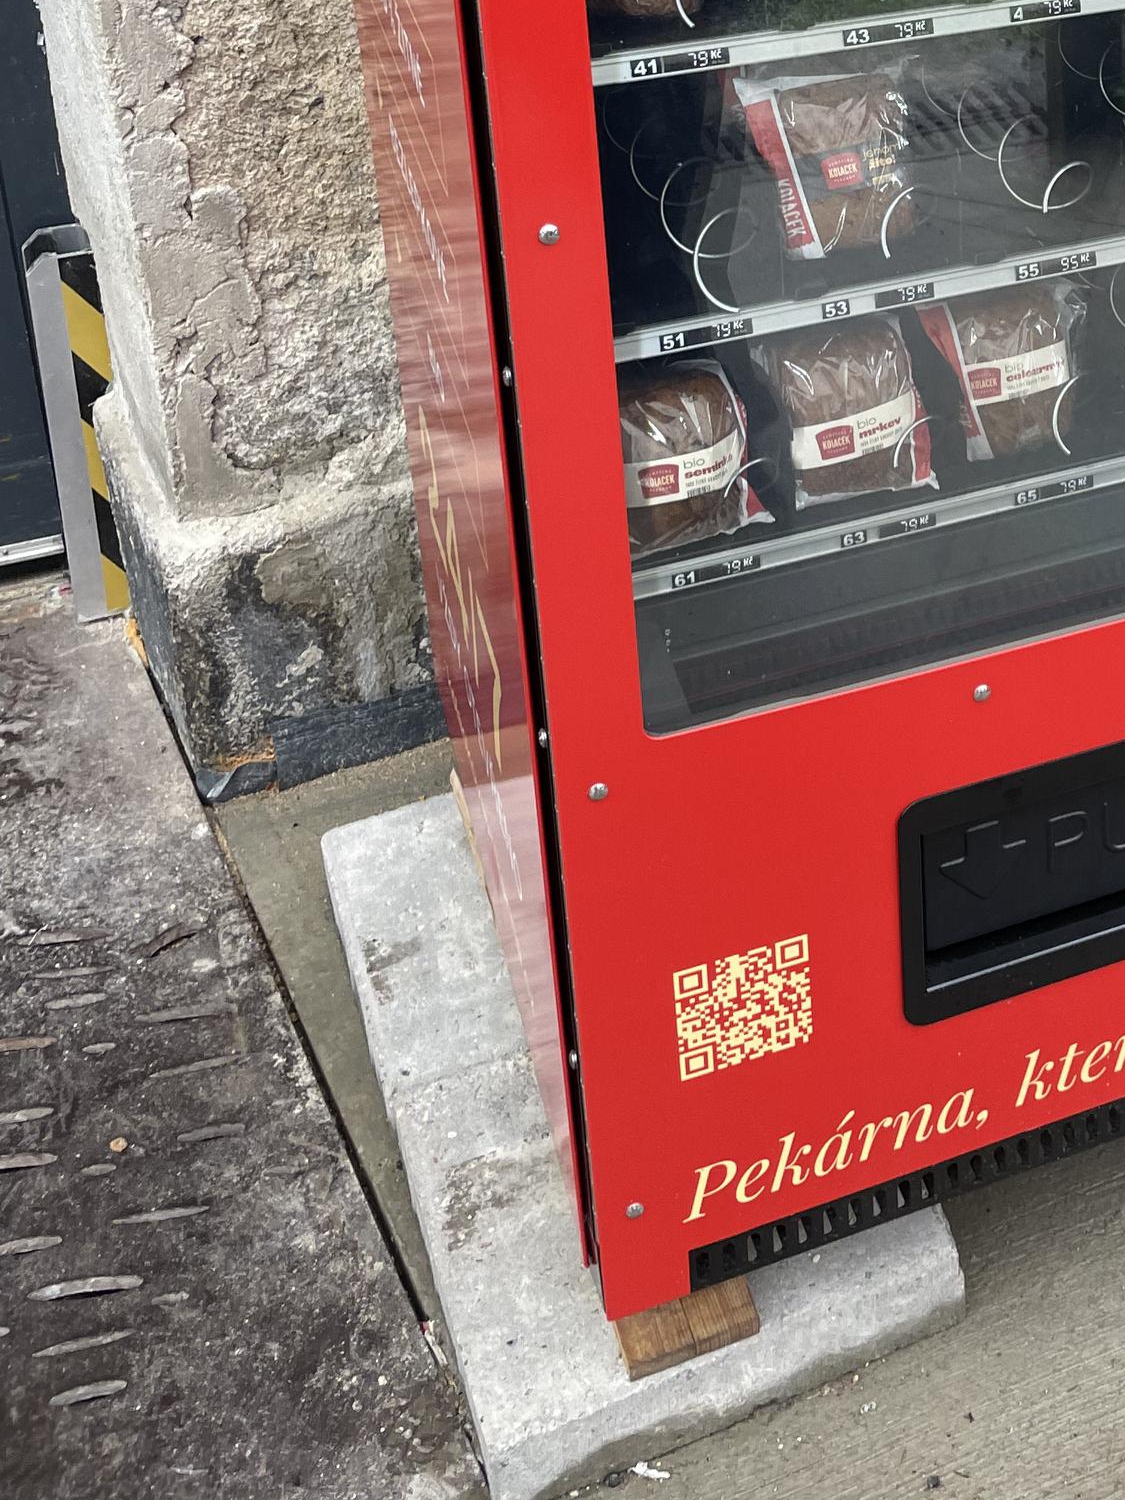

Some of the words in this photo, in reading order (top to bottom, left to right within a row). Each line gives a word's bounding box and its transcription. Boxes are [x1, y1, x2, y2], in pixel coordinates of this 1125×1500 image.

[1013, 5, 1024, 21] 4
[1044, 0, 1062, 15] 79
[846, 29, 870, 45] 43
[895, 23, 913, 38] 79
[633, 59, 658, 75] 41
[688, 51, 709, 67] 79
[1018, 263, 1040, 278] 55
[1060, 255, 1079, 271] 95
[825, 301, 848, 317] 53
[898, 286, 915, 301] 79
[663, 332, 685, 350] 51
[712, 322, 731, 338] 79
[857, 416, 877, 429] bio
[859, 416, 902, 439] mrkev
[683, 457, 705, 469] bio
[643, 474, 675, 488] OLACEK
[1017, 489, 1037, 504] 65
[1059, 479, 1077, 493] 79
[843, 532, 865, 547] 63
[901, 517, 918, 532] 79
[674, 571, 696, 587] 61
[723, 560, 741, 574] 79
[682, 1084, 990, 1223] Pekárna,
